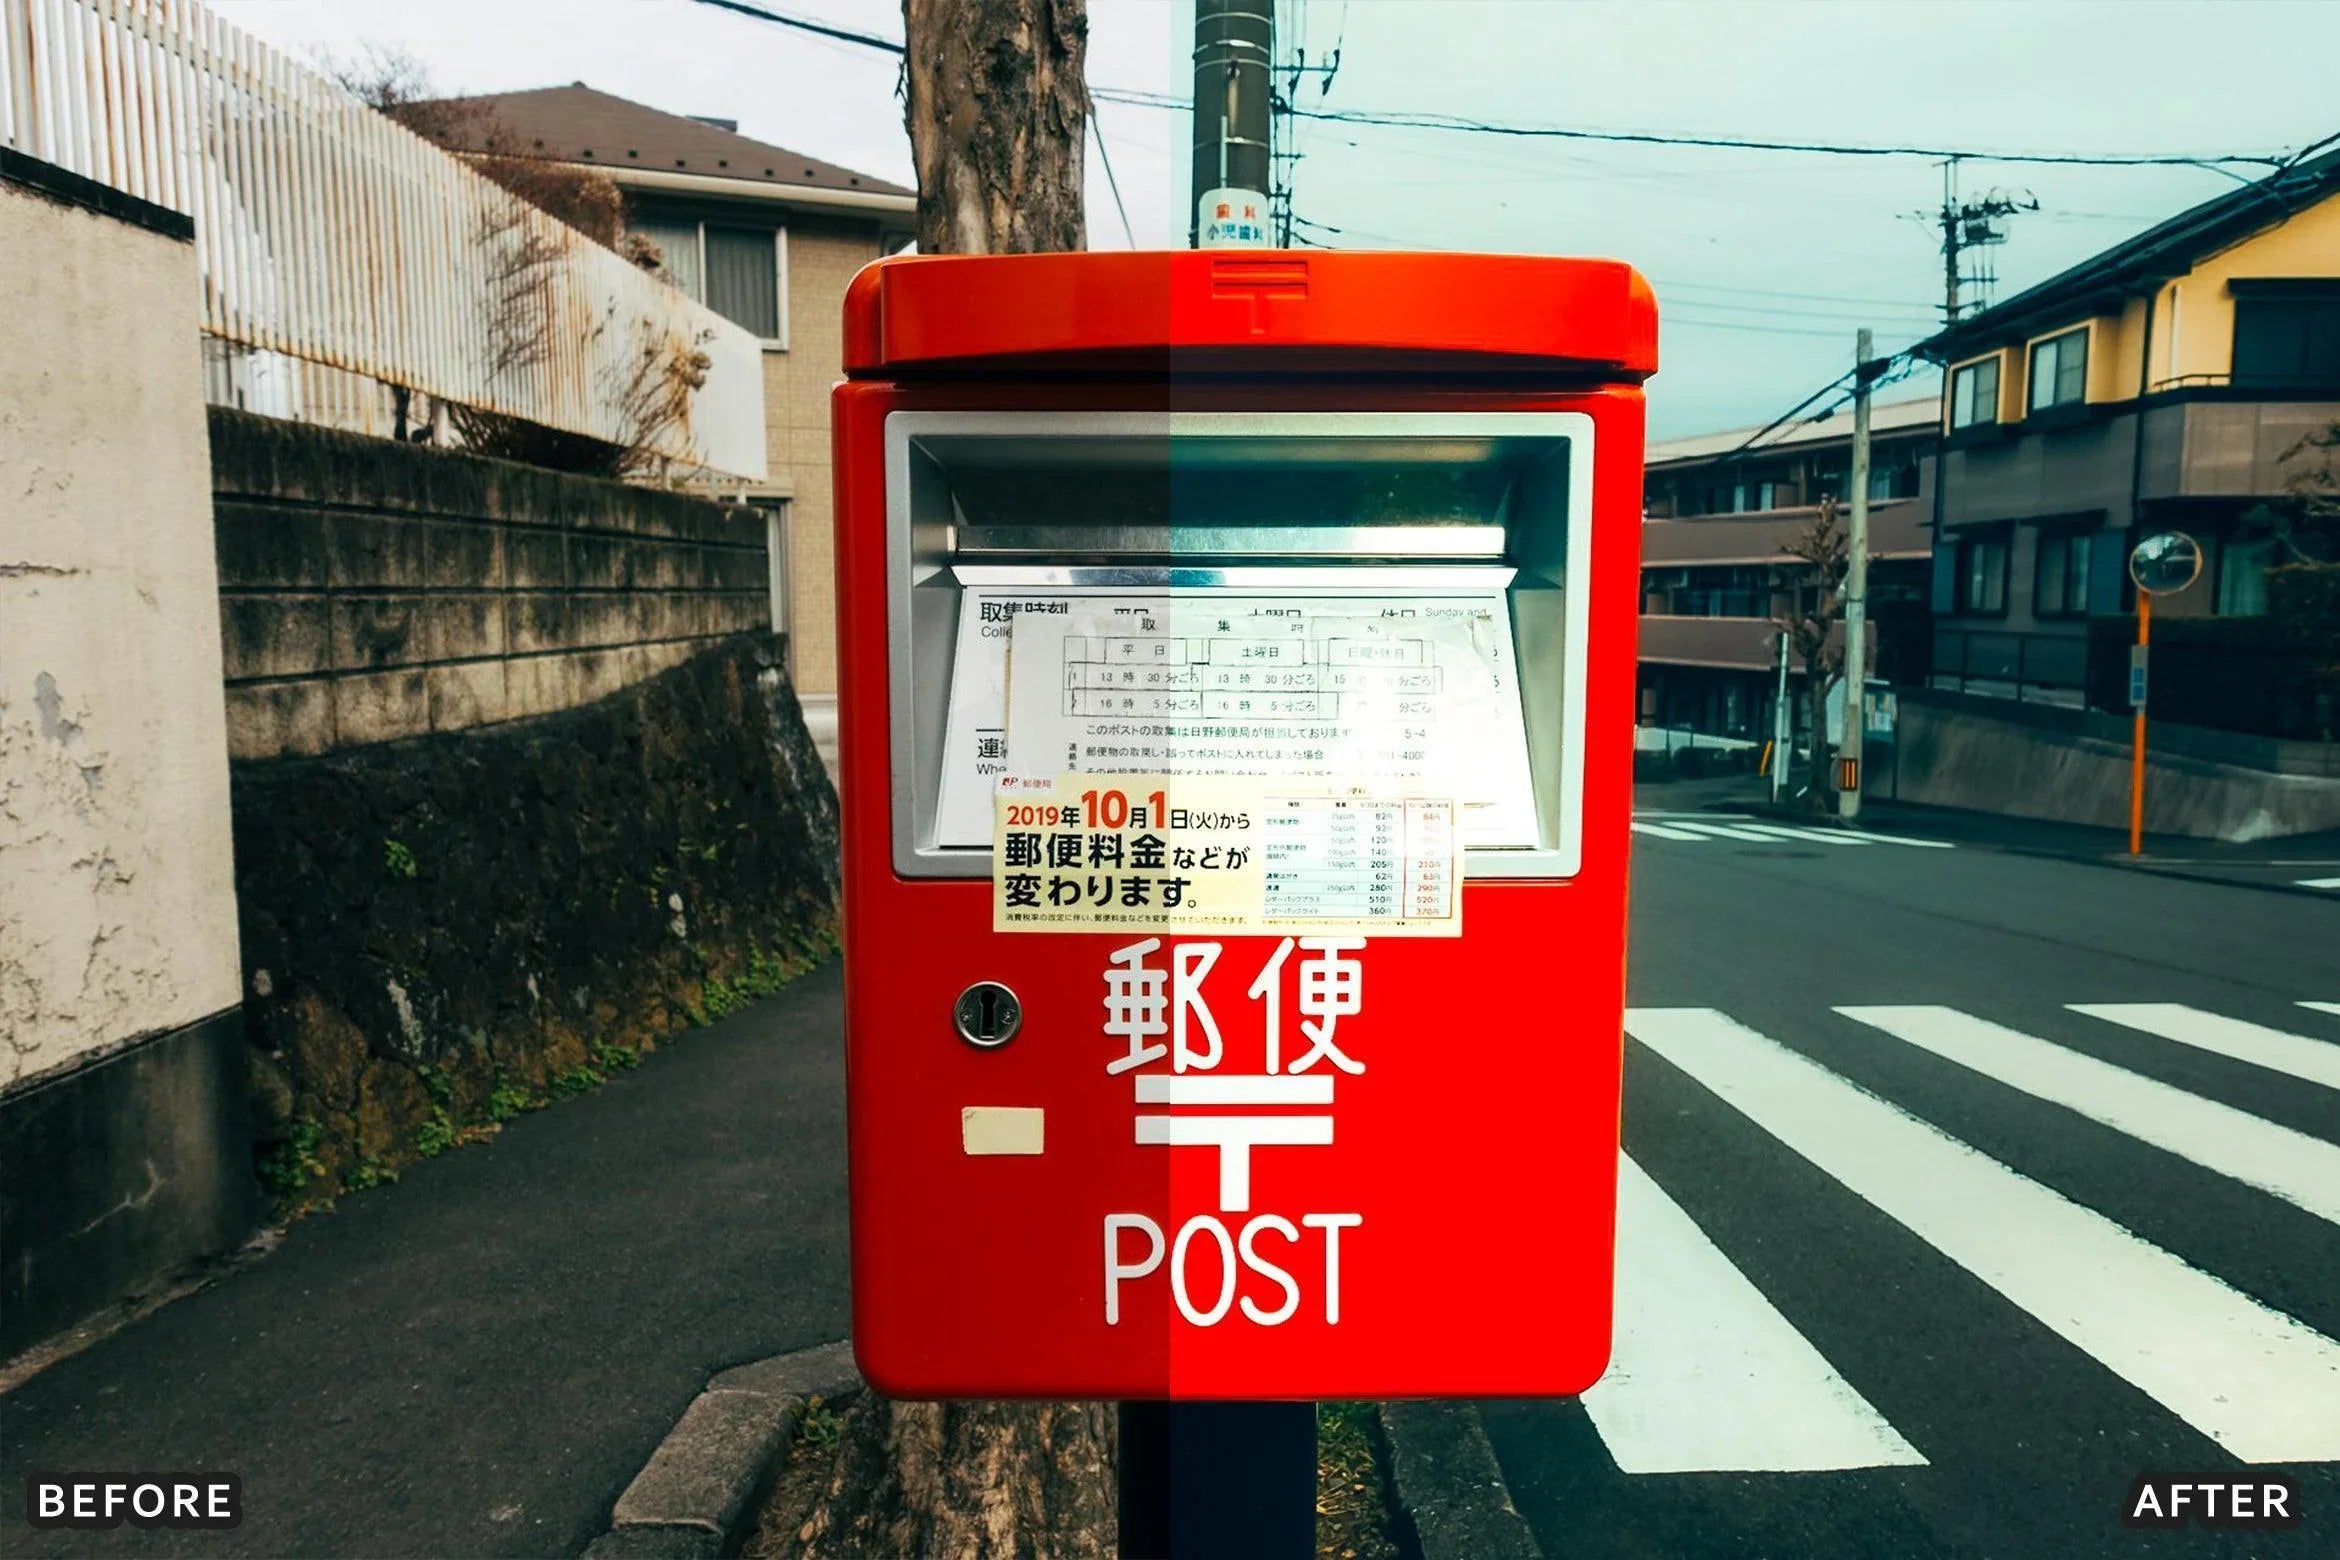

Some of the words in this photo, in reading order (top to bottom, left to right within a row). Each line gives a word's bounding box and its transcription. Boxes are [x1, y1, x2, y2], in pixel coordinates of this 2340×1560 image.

[1005, 832, 1250, 870] 郵便料金などが
[1005, 873, 1197, 909] 変わります。
[1103, 936, 1368, 1076] 郵便
[1104, 1213, 1364, 1328] POST
